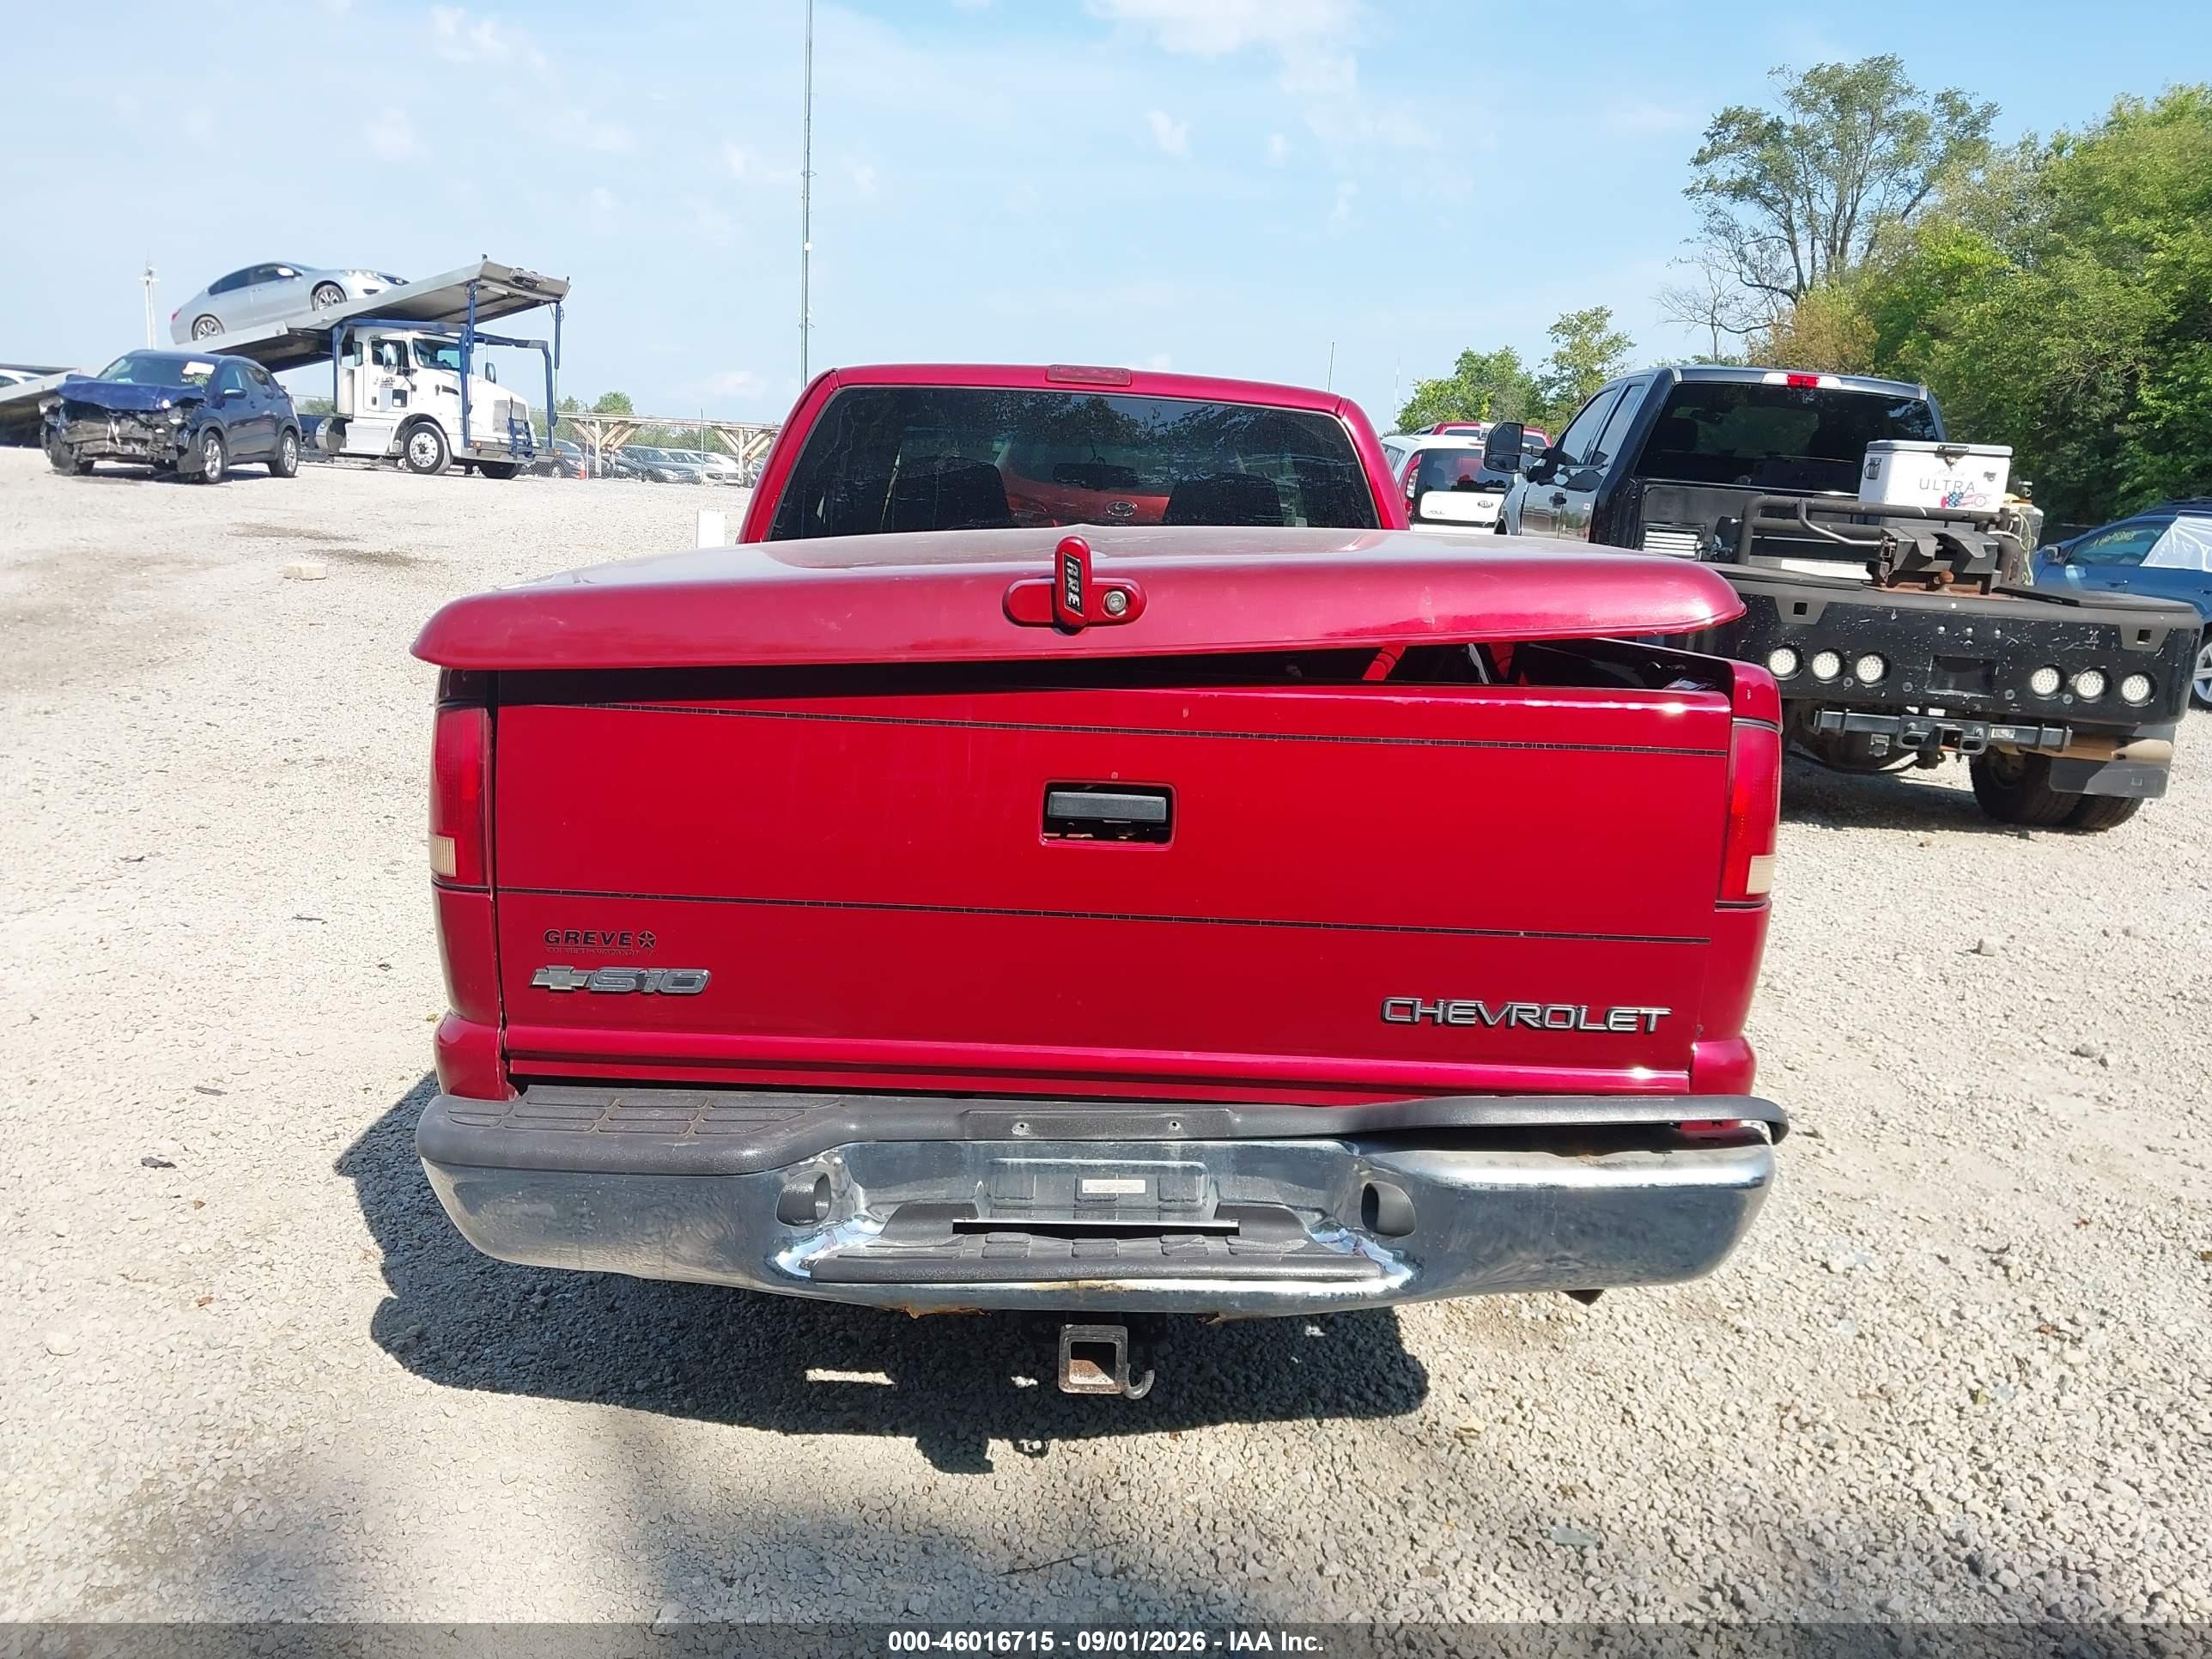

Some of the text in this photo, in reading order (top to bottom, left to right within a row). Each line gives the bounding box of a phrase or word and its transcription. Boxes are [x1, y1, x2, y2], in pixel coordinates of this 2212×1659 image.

[1919, 478, 1975, 494] ULTRA
[544, 929, 634, 946] GREVE
[589, 967, 711, 994] S10
[1382, 997, 1672, 1034] CHEVROLET
